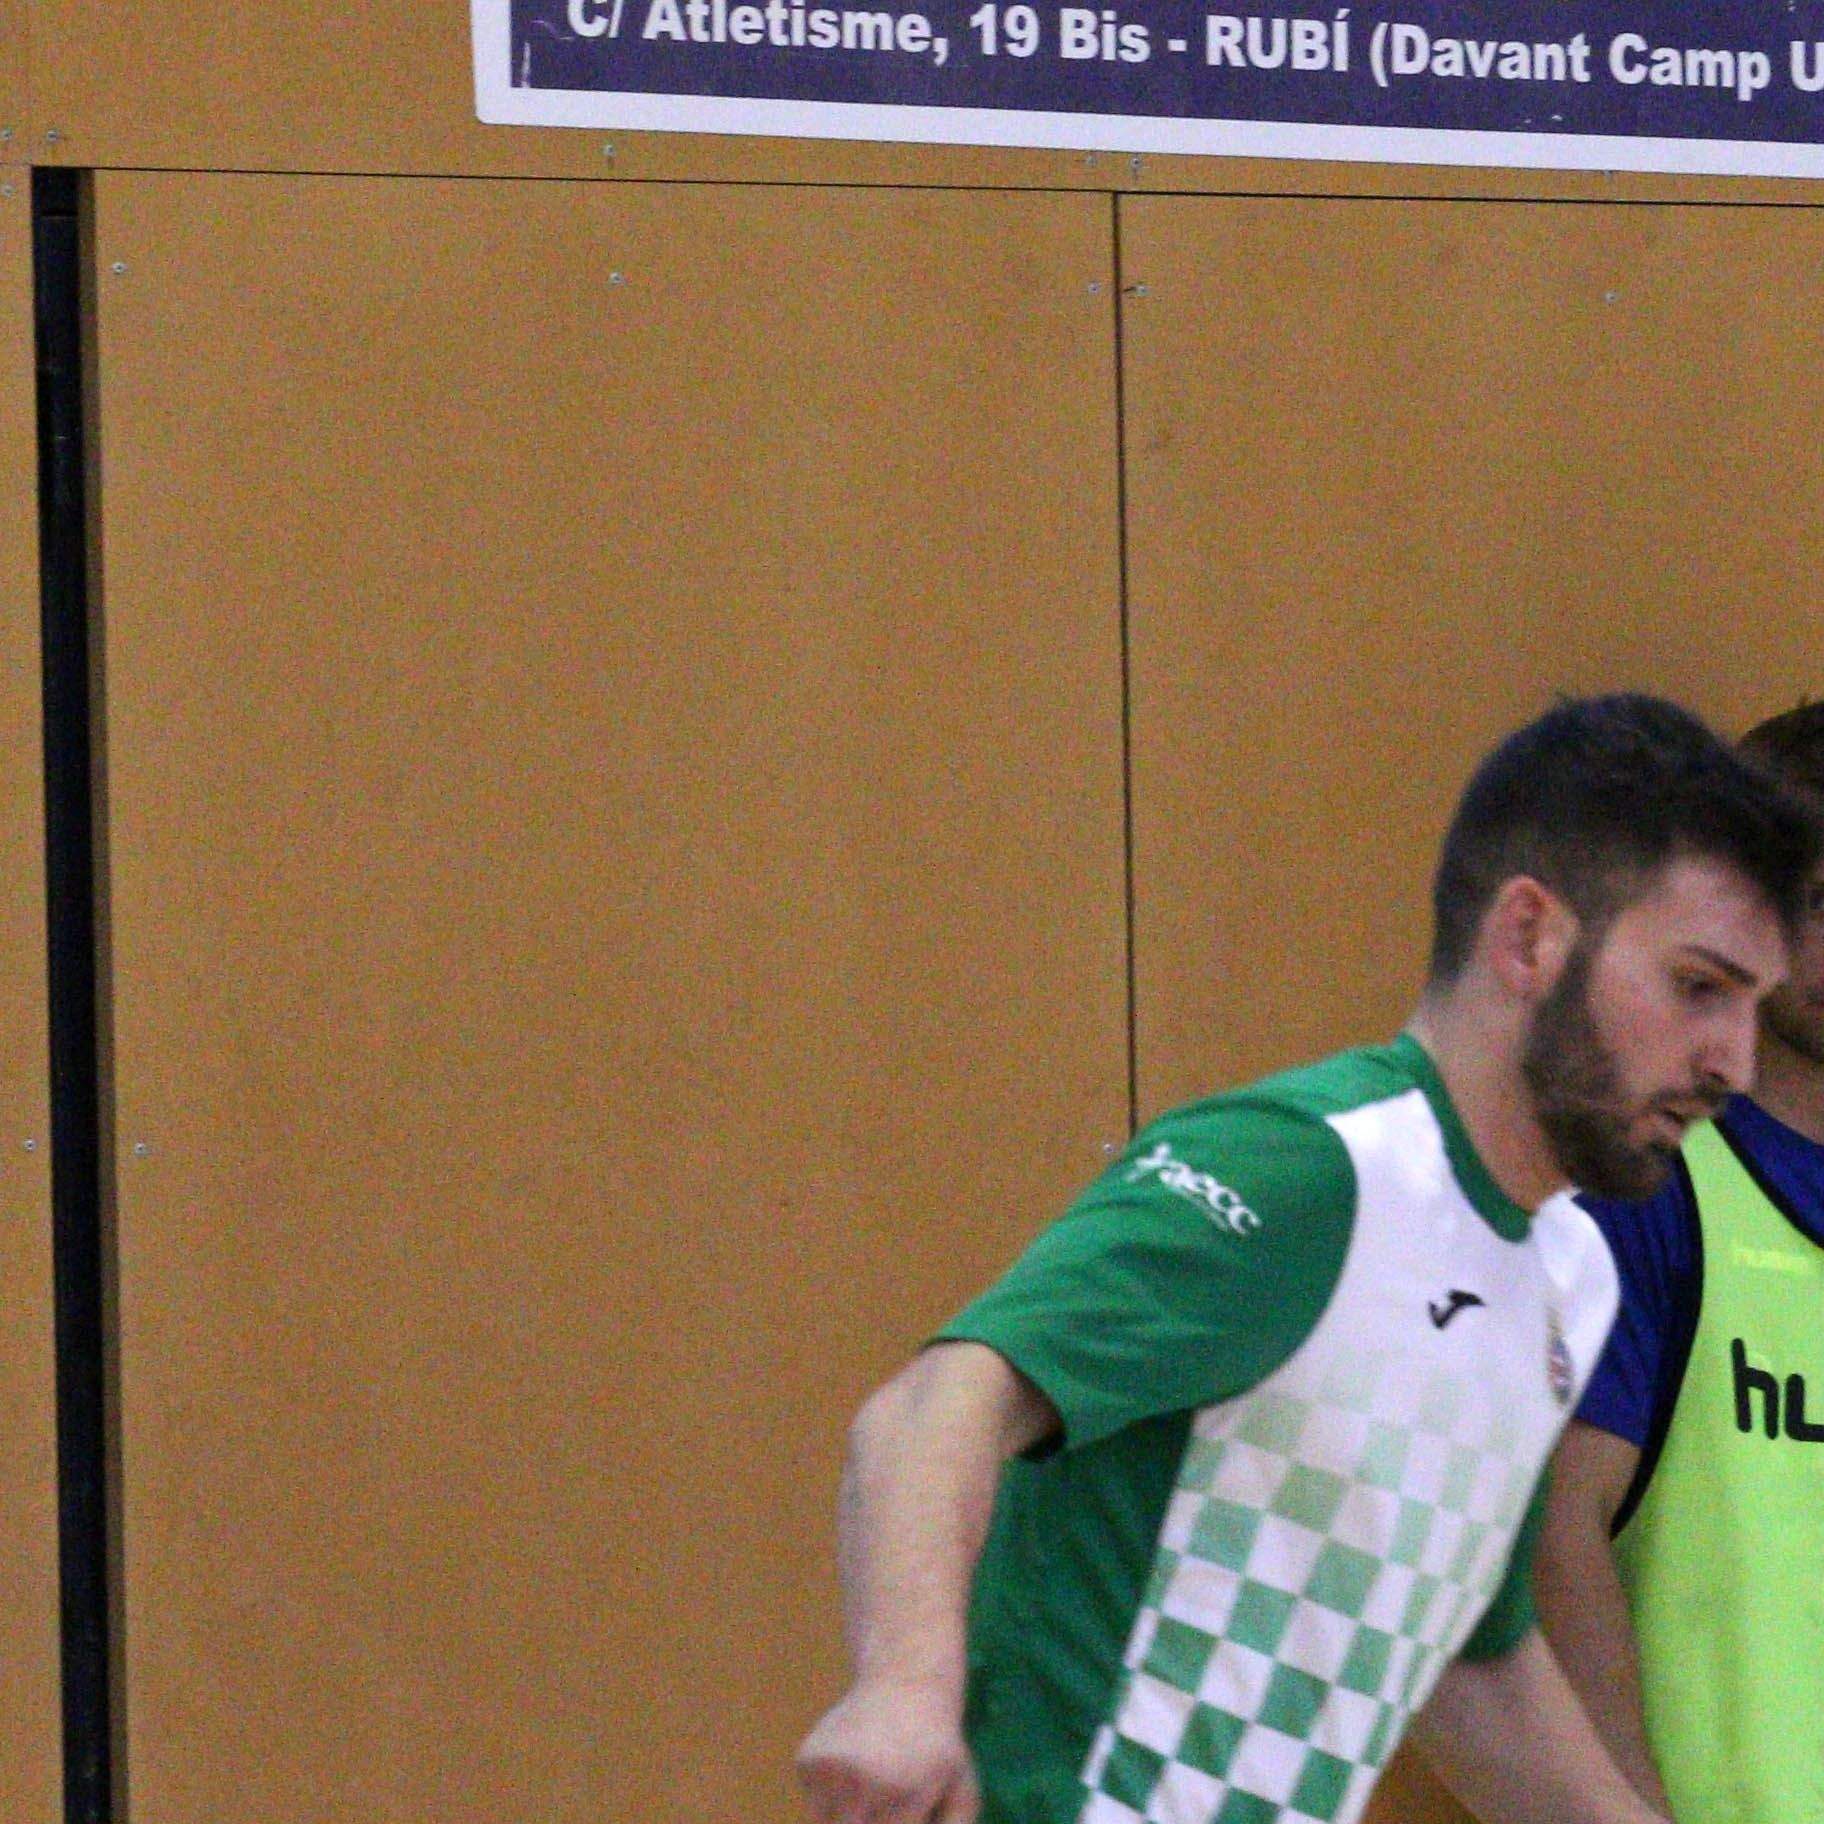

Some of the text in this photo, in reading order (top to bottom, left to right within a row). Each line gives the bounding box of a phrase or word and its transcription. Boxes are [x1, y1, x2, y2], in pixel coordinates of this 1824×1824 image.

[567, 0, 624, 38] C/
[642, 0, 948, 66] Atletisme,
[970, 3, 1039, 58] 19
[1060, 8, 1151, 63] Bis
[1167, 39, 1187, 52] -
[1206, 8, 1350, 72] RUBÍ
[1370, 22, 1591, 88] (Davant
[1609, 32, 1771, 102] Camp
